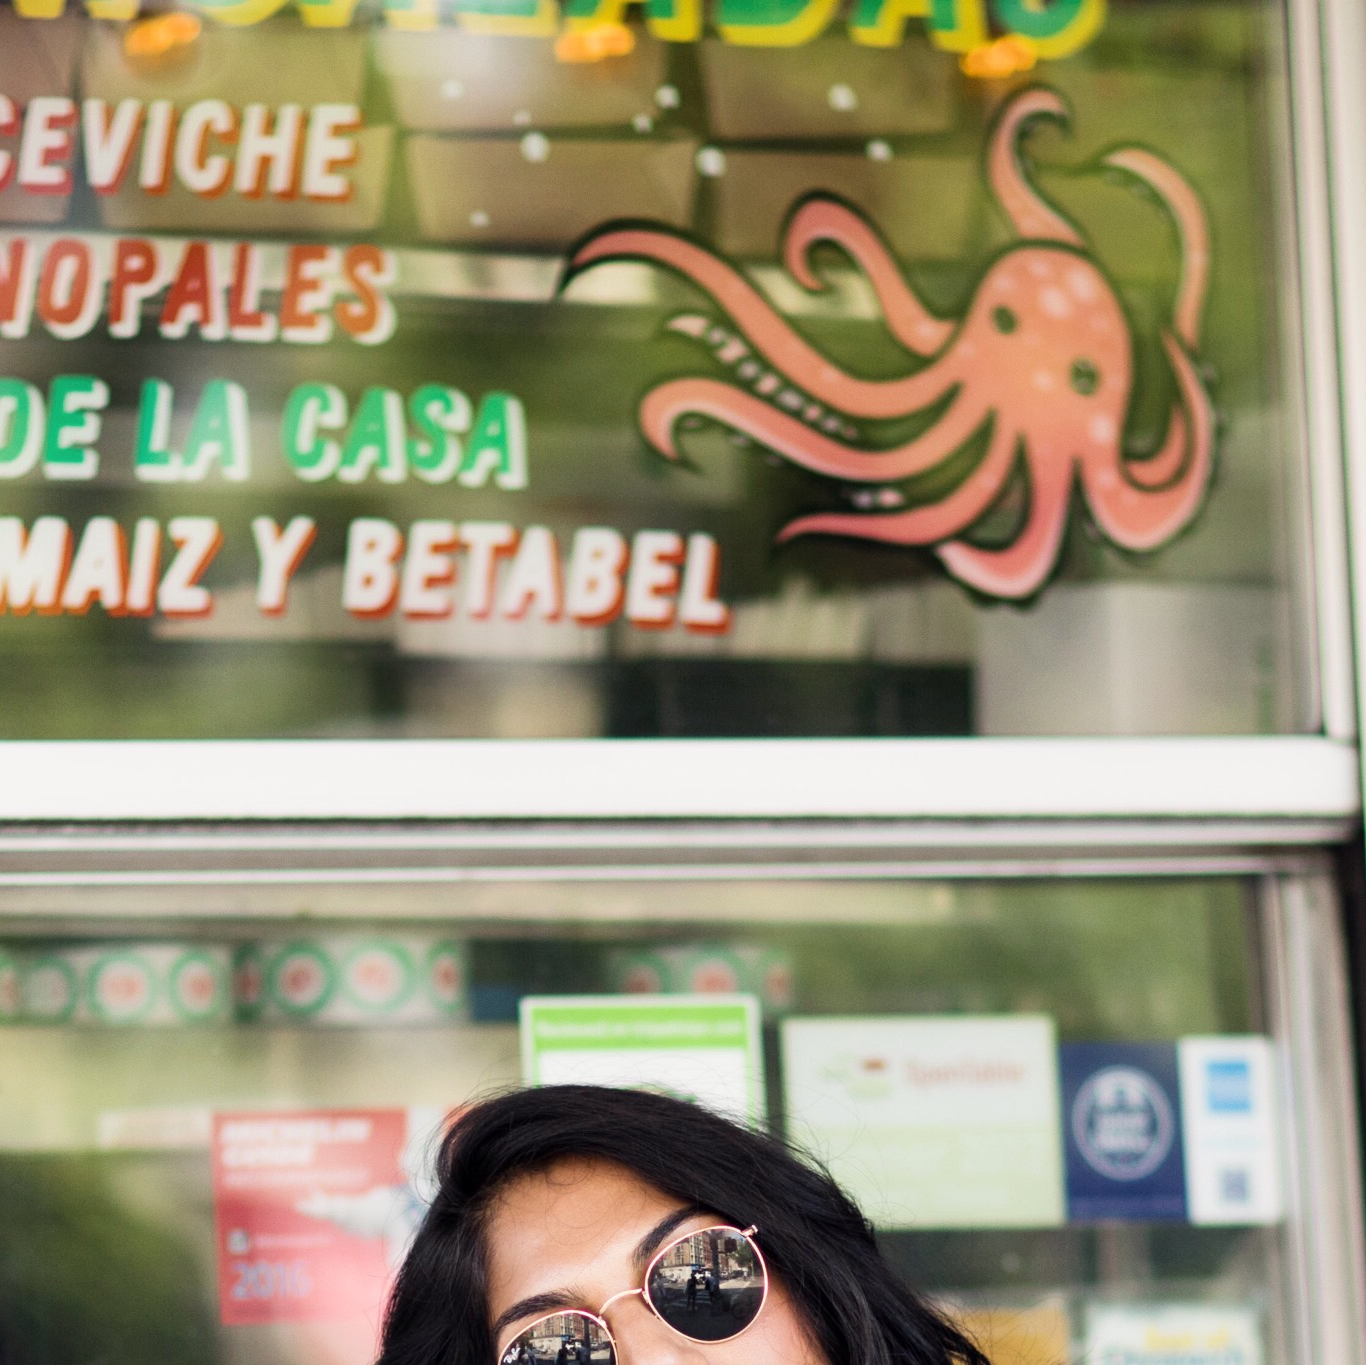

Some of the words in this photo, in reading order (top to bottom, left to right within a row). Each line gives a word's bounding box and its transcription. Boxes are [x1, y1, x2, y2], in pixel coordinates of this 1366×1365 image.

[134, 376, 252, 483] LA
[281, 382, 528, 490] CASA
[253, 516, 315, 618] Y
[343, 517, 730, 634] BETABEL
